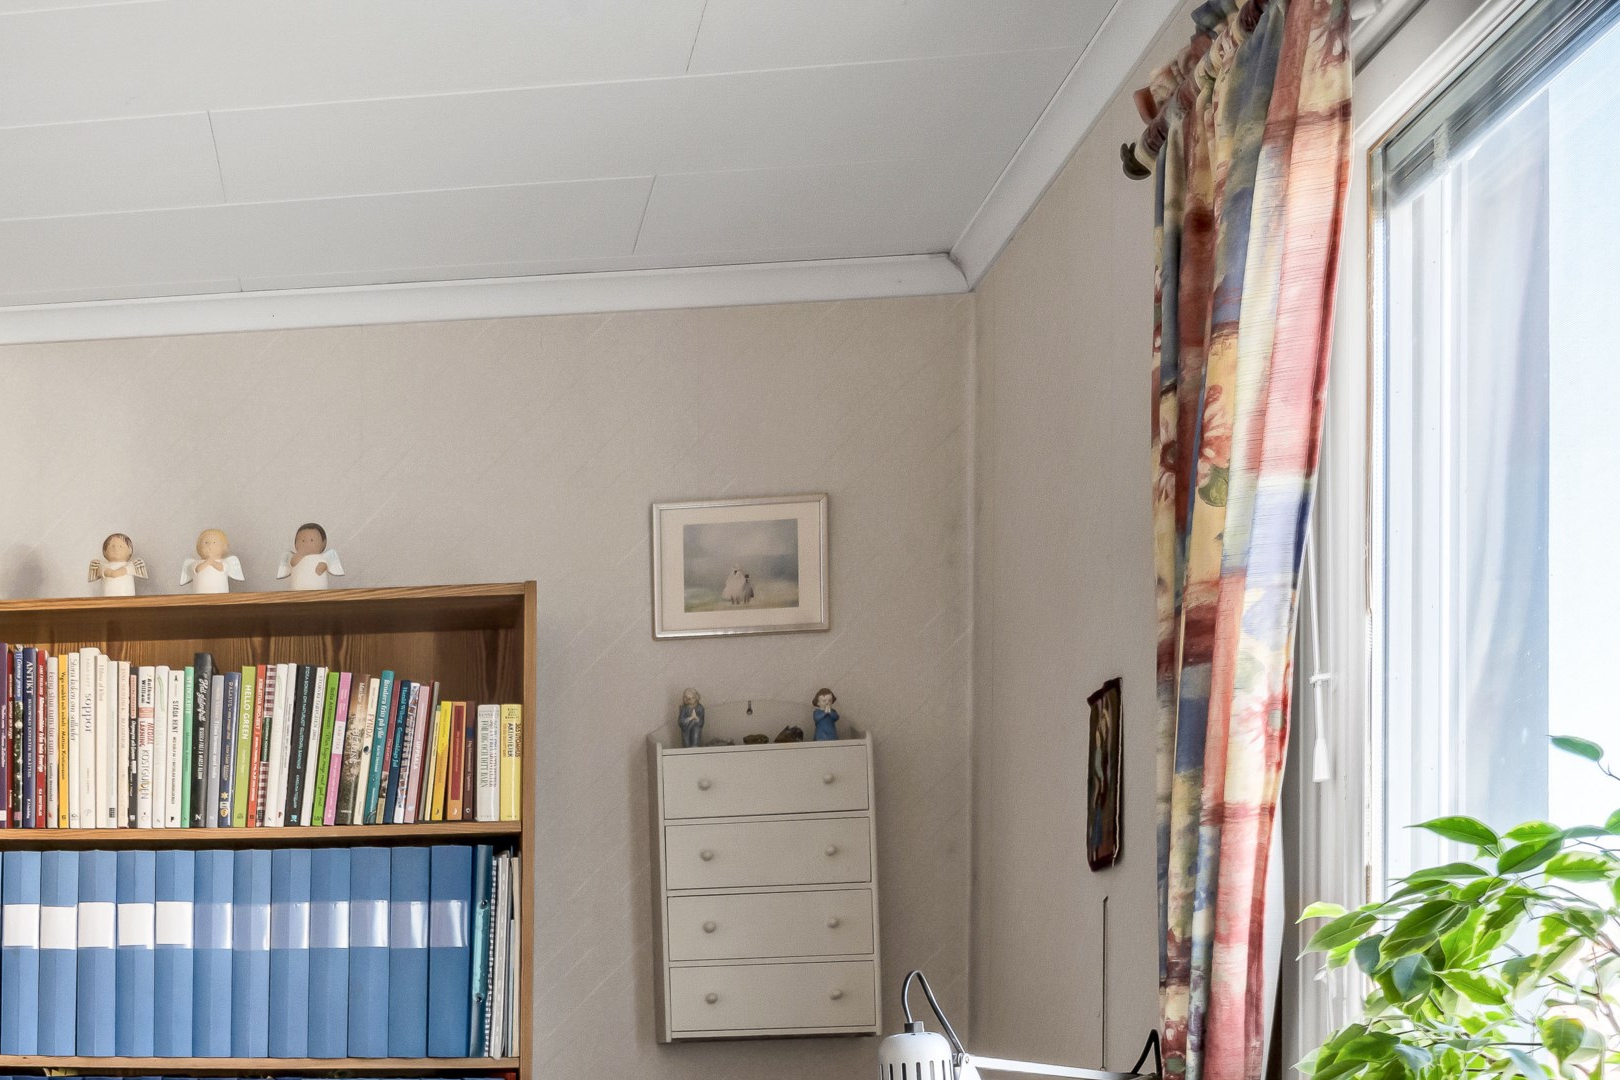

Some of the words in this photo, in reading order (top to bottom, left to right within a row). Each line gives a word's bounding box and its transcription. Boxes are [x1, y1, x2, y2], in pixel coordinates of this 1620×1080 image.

[26, 661, 34, 695] ANTIKT
[46, 672, 55, 691] Feng
[243, 685, 252, 711] HELLO
[380, 680, 391, 704] Brodera
[82, 693, 92, 733] soppor
[377, 719, 385, 727] på
[380, 706, 389, 718] fritt
[242, 713, 251, 740] GREEN
[365, 714, 375, 739] FYNDA
[480, 734, 488, 743] DIG
[481, 721, 489, 733] FÖR
[413, 741, 422, 770] UPPSALA
[140, 750, 149, 799] KOSTGUIDEN
[480, 772, 488, 788] BARN
